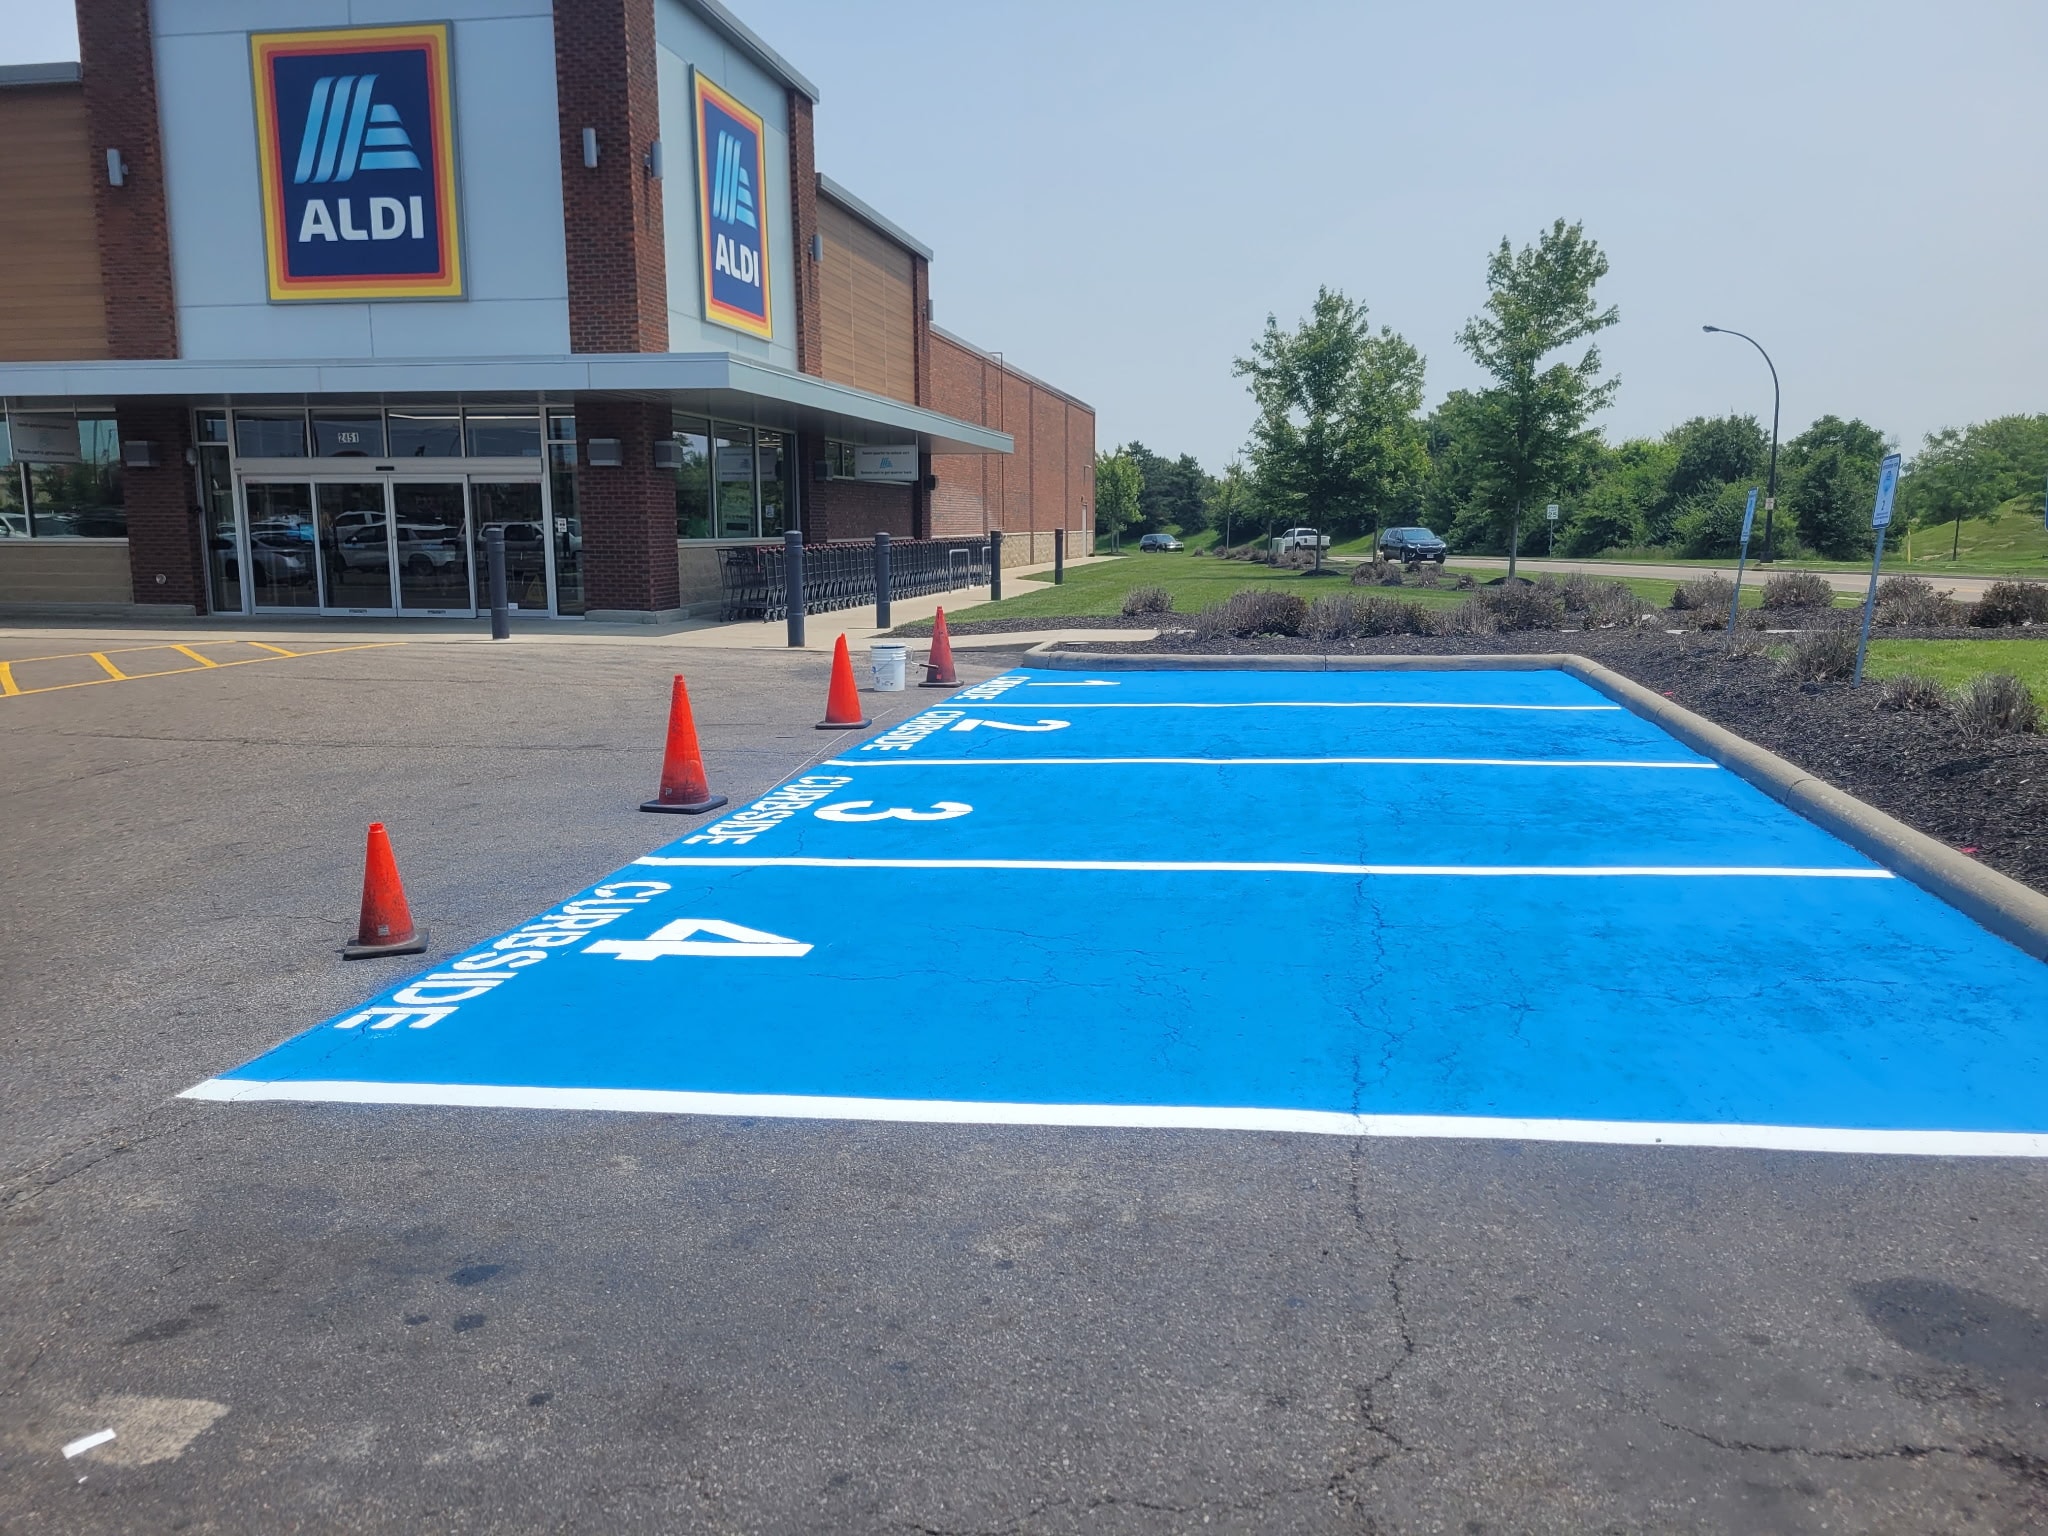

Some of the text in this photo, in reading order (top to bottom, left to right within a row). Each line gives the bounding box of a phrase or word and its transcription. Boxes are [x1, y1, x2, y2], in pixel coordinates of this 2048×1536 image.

[298, 195, 425, 243] ALDI
[715, 233, 760, 288] ALDI
[338, 432, 358, 443] 2451
[1027, 679, 1121, 687] 1
[861, 710, 966, 751] CURBSIDE
[950, 718, 1071, 732] 2
[682, 775, 854, 845] CURBSIDE
[813, 800, 974, 822] 3
[334, 881, 672, 1030] CURBSIDE
[580, 918, 815, 961] 4
